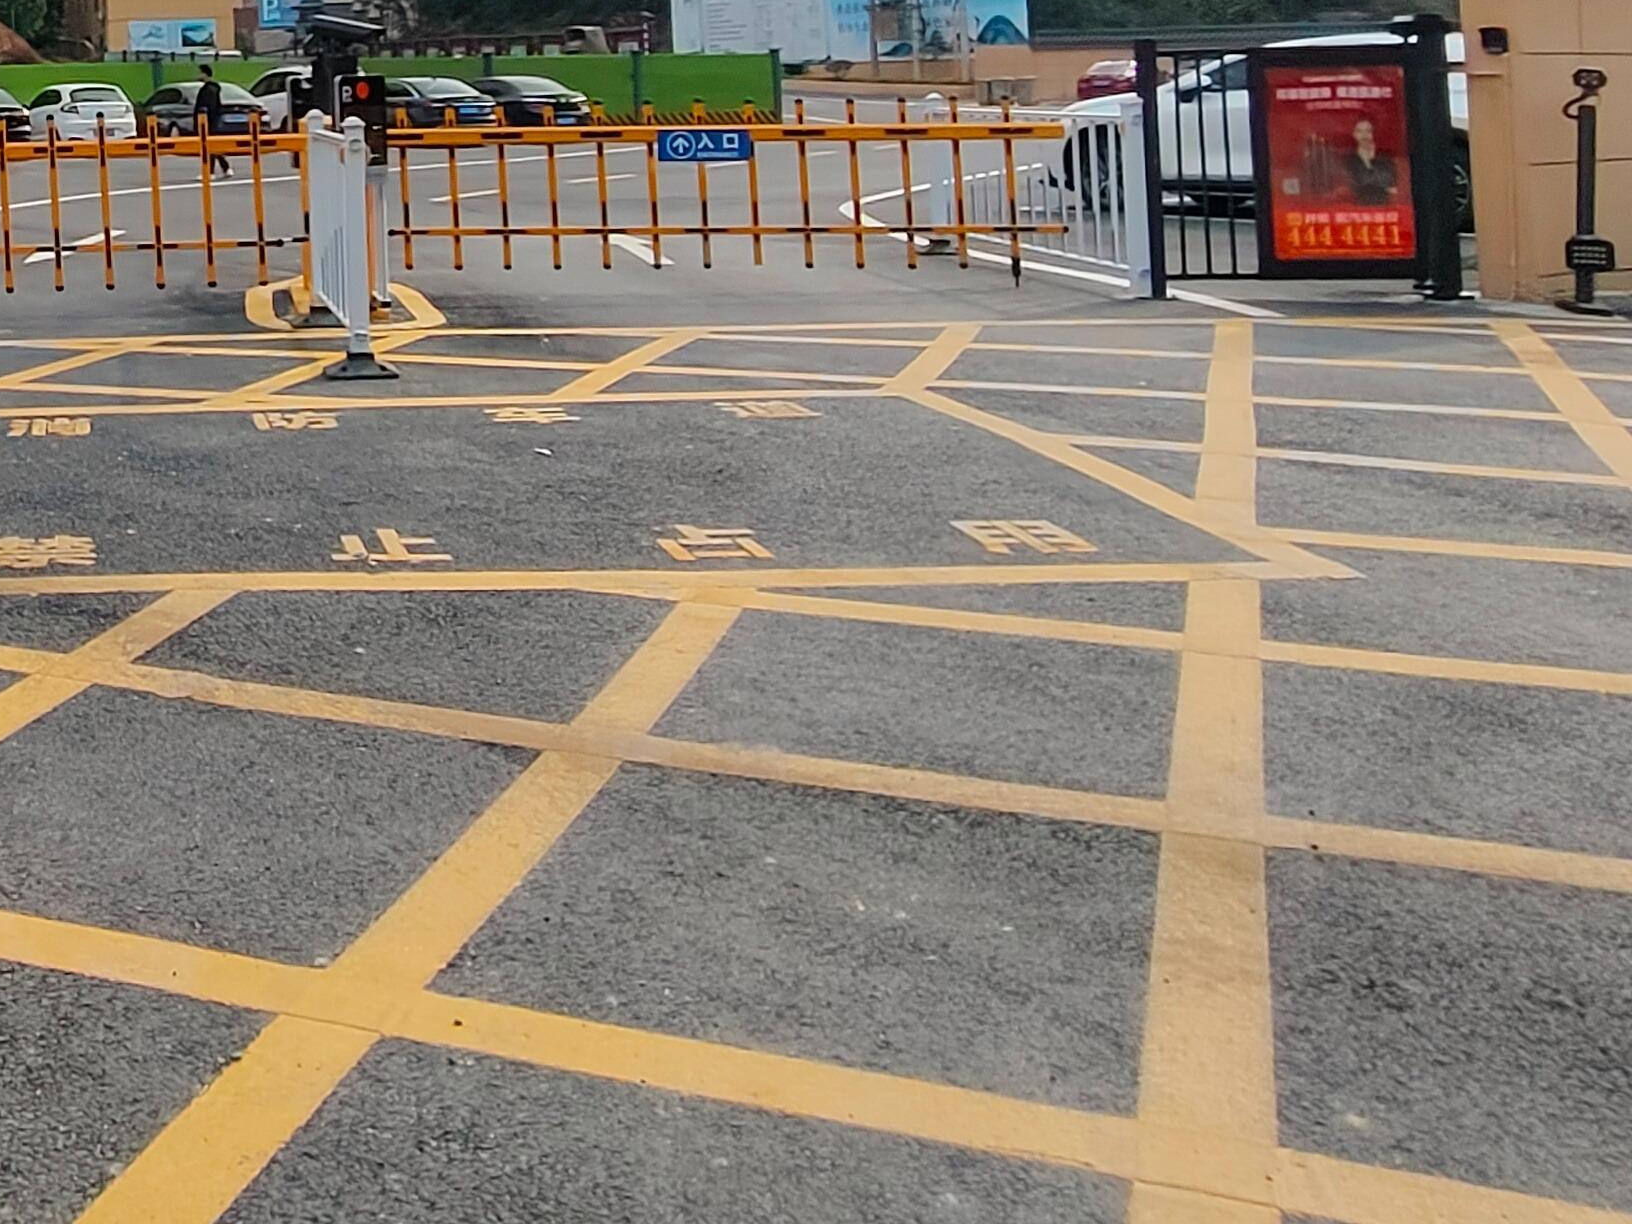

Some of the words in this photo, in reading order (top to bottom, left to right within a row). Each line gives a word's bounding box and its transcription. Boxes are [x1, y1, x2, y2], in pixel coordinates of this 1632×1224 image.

[697, 133, 739, 149] 入口
[7, 400, 823, 437] 消防车道
